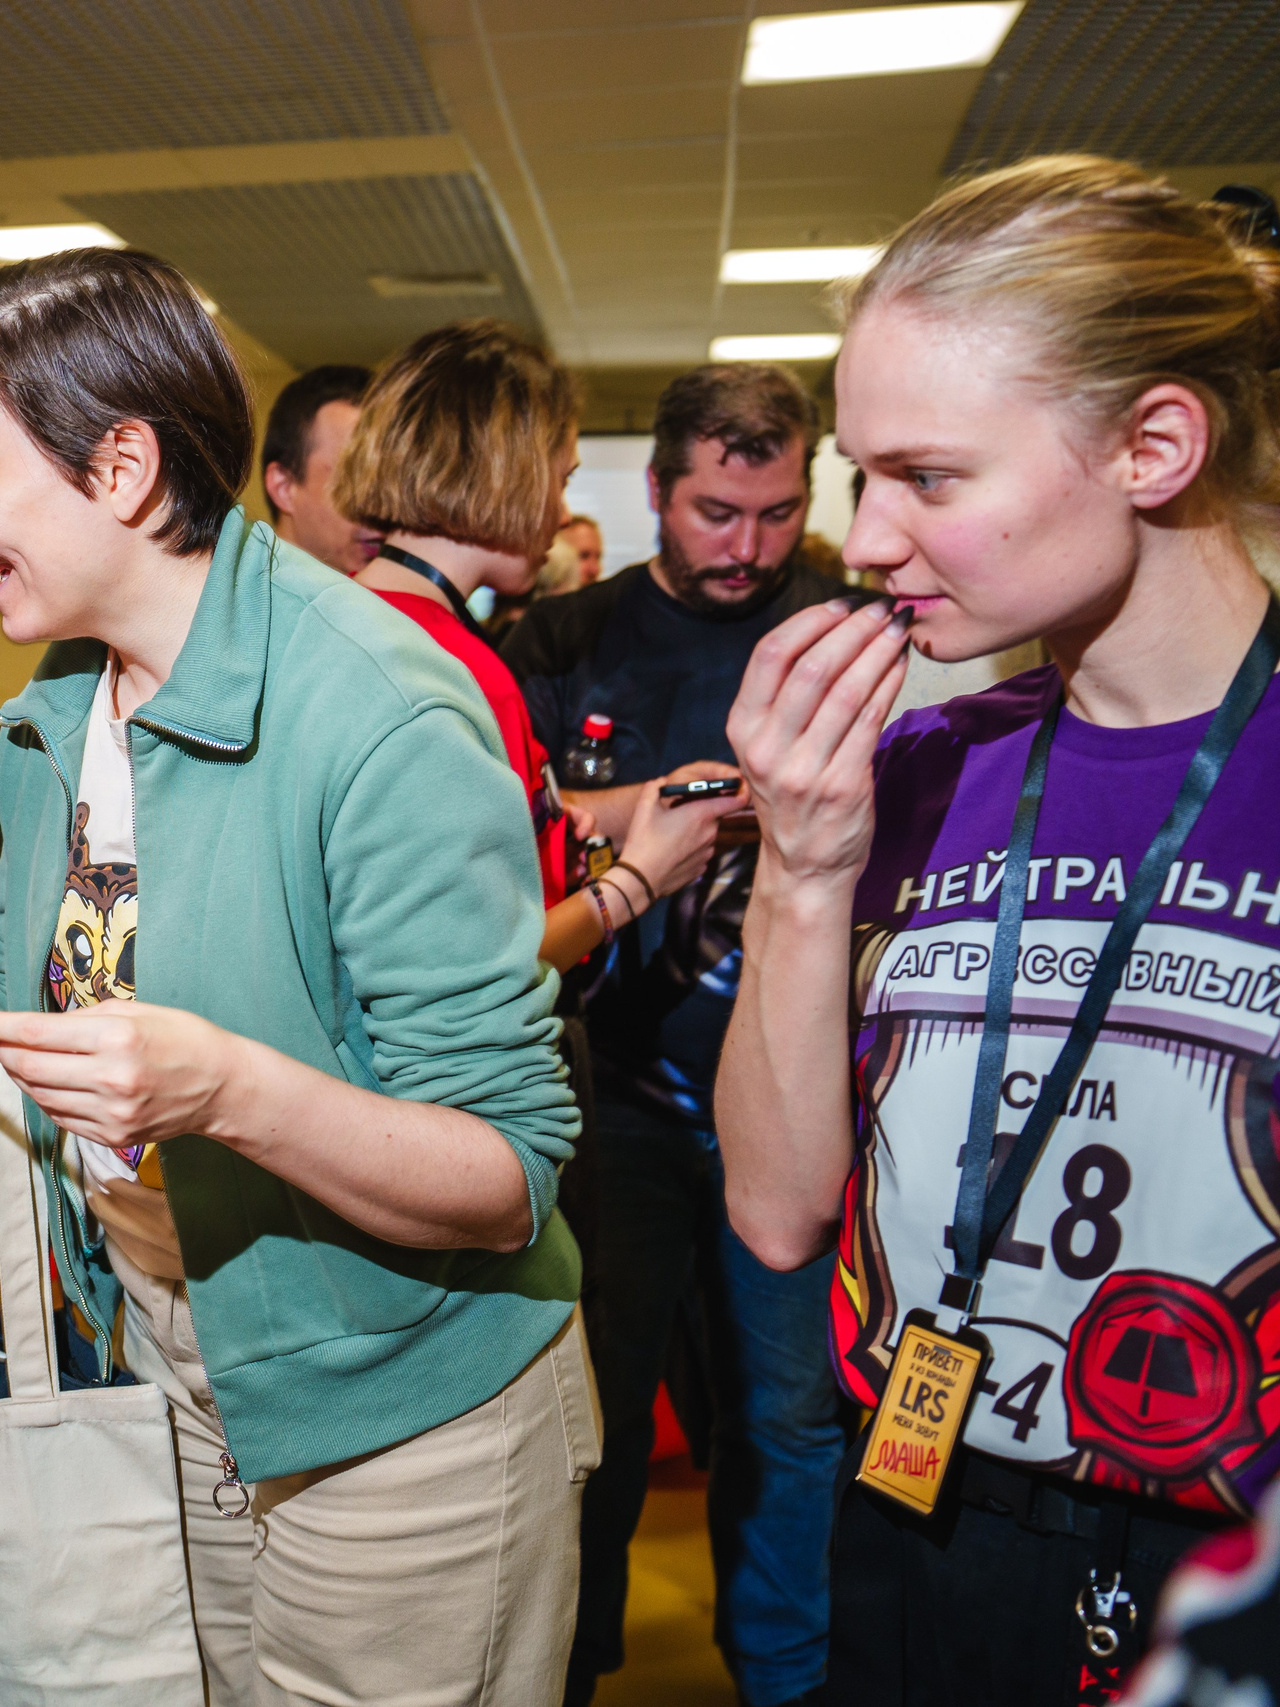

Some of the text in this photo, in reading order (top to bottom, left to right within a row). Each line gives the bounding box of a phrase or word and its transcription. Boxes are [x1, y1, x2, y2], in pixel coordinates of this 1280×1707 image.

[890, 942, 1280, 1018] АГРССВНЫЙ
[913, 1342, 964, 1376] ПРИВЕТ!
[899, 1376, 949, 1424] LRS
[892, 1413, 940, 1442] МЕНЯ ЗОВУТ
[869, 1439, 941, 1480] МАША
